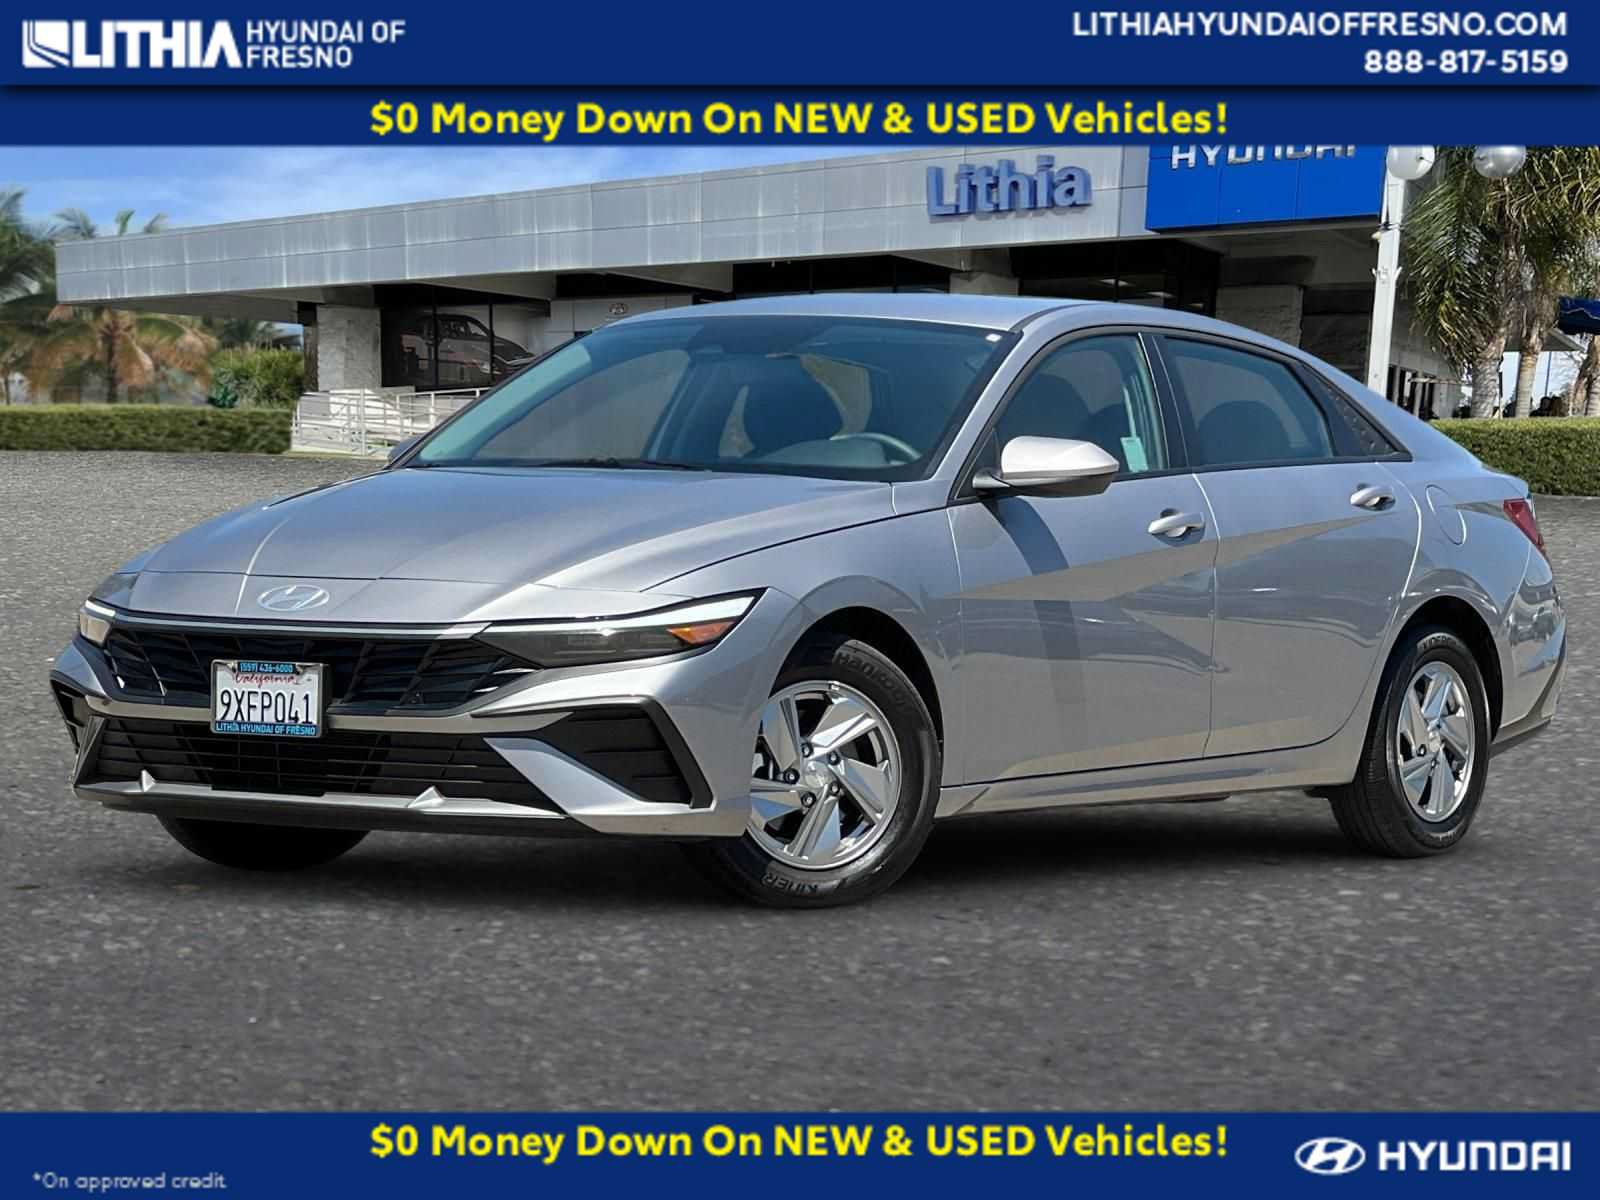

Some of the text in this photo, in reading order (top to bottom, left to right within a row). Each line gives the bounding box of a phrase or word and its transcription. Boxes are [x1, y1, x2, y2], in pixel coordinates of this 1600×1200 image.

[927, 154, 1093, 216] Lithia
[220, 689, 313, 724] 9XFP041
[241, 724, 273, 733] HYUNDAI
[275, 725, 285, 734] OF
[286, 726, 316, 735] FRESNO
